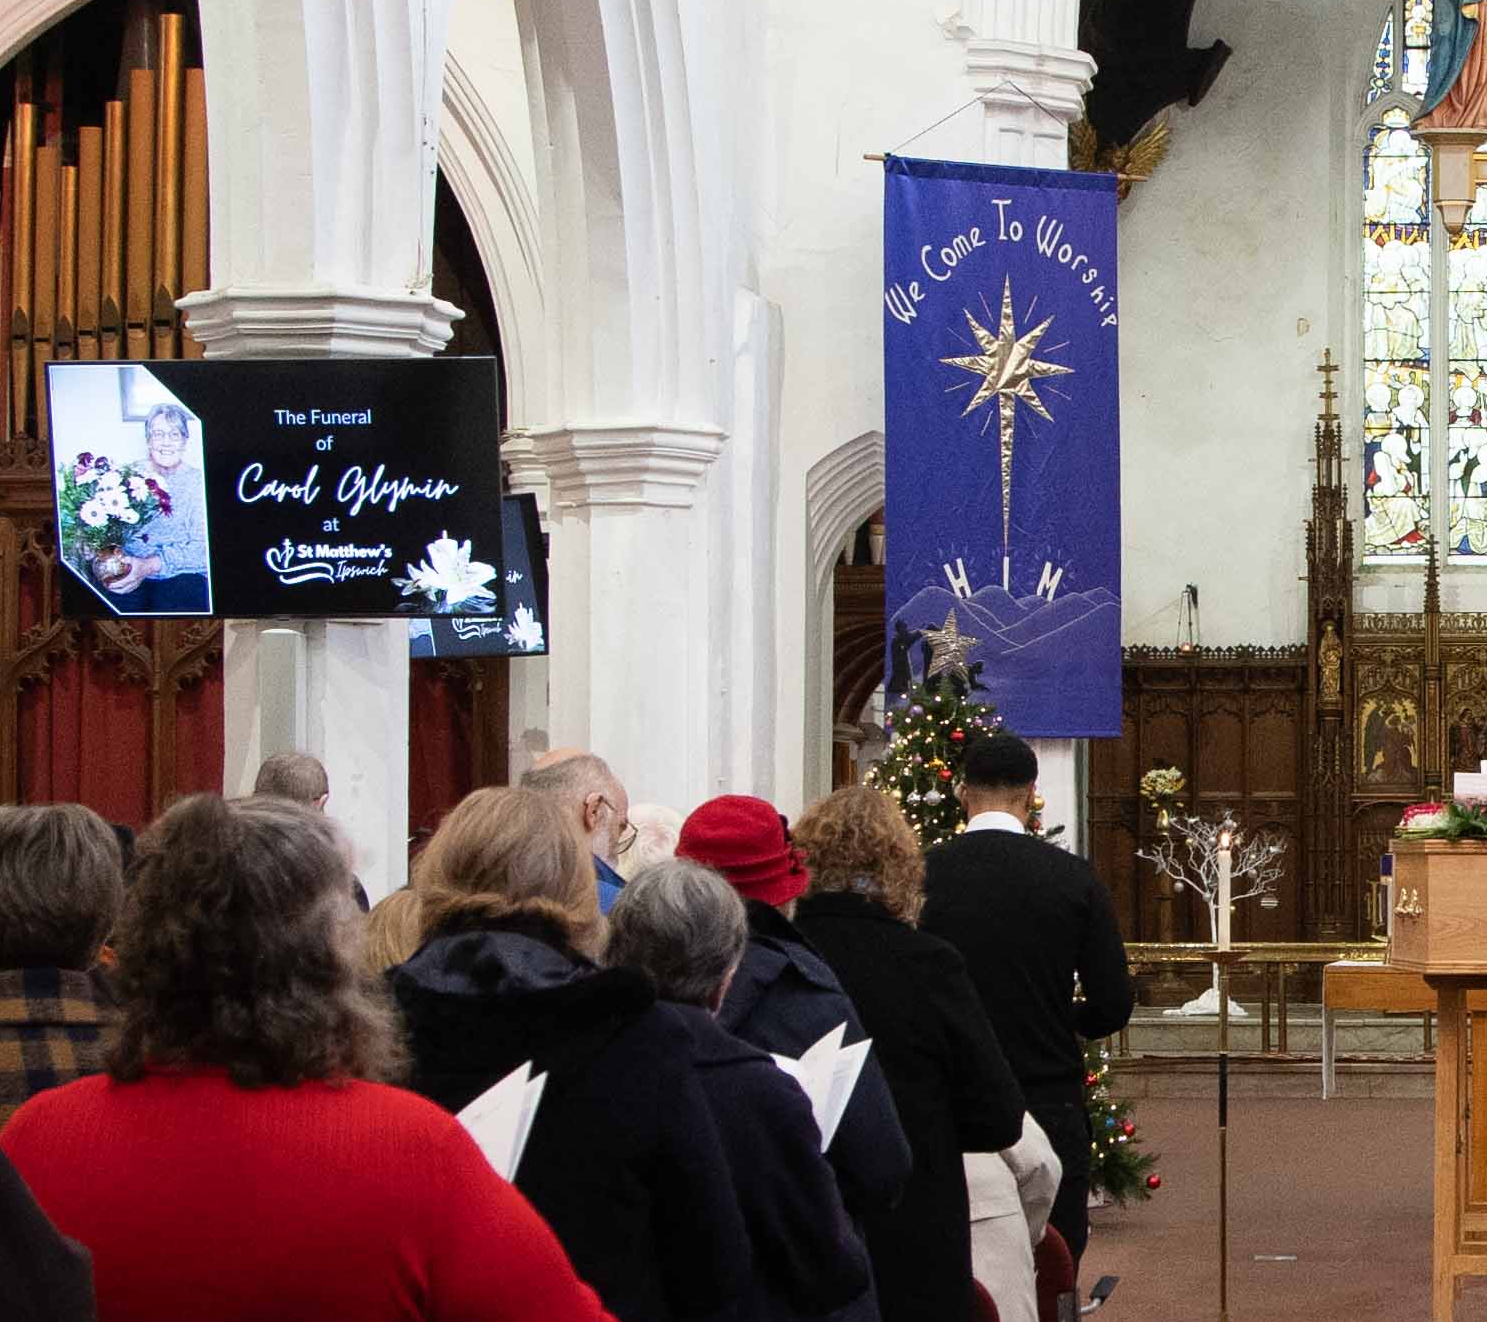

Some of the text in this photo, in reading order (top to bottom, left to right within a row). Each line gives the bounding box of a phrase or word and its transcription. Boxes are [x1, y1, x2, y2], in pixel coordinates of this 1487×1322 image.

[884, 199, 1118, 327] We Come To Worship
[274, 408, 372, 426] The Funeral
[316, 435, 334, 451] of
[238, 462, 321, 505] Carol
[322, 517, 340, 532] at
[297, 544, 393, 559] St Matthew's
[335, 559, 389, 581] Ipswich
